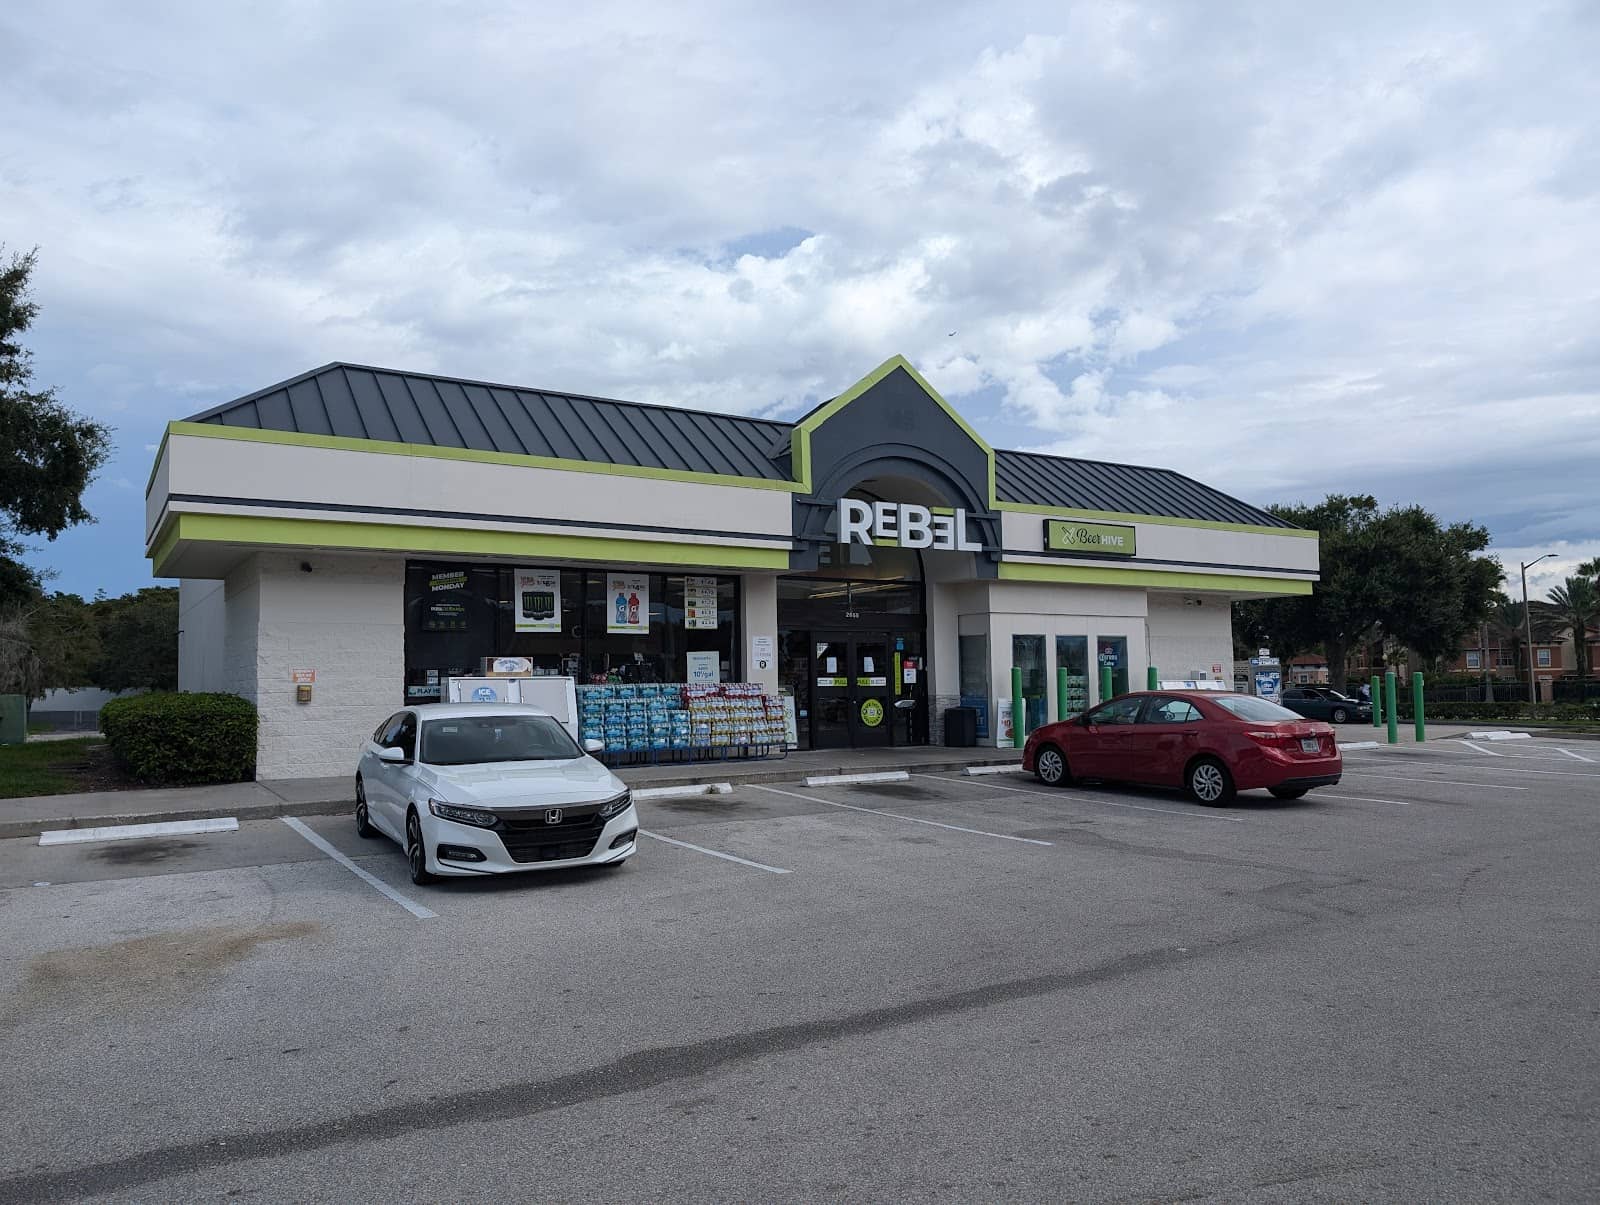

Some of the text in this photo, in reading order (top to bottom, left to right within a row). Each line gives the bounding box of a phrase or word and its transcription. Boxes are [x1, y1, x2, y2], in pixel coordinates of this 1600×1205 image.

[838, 498, 983, 552] REBEL
[431, 582, 465, 592] MONDAY
[417, 687, 430, 695] PLAY
[478, 688, 491, 696] ICE
